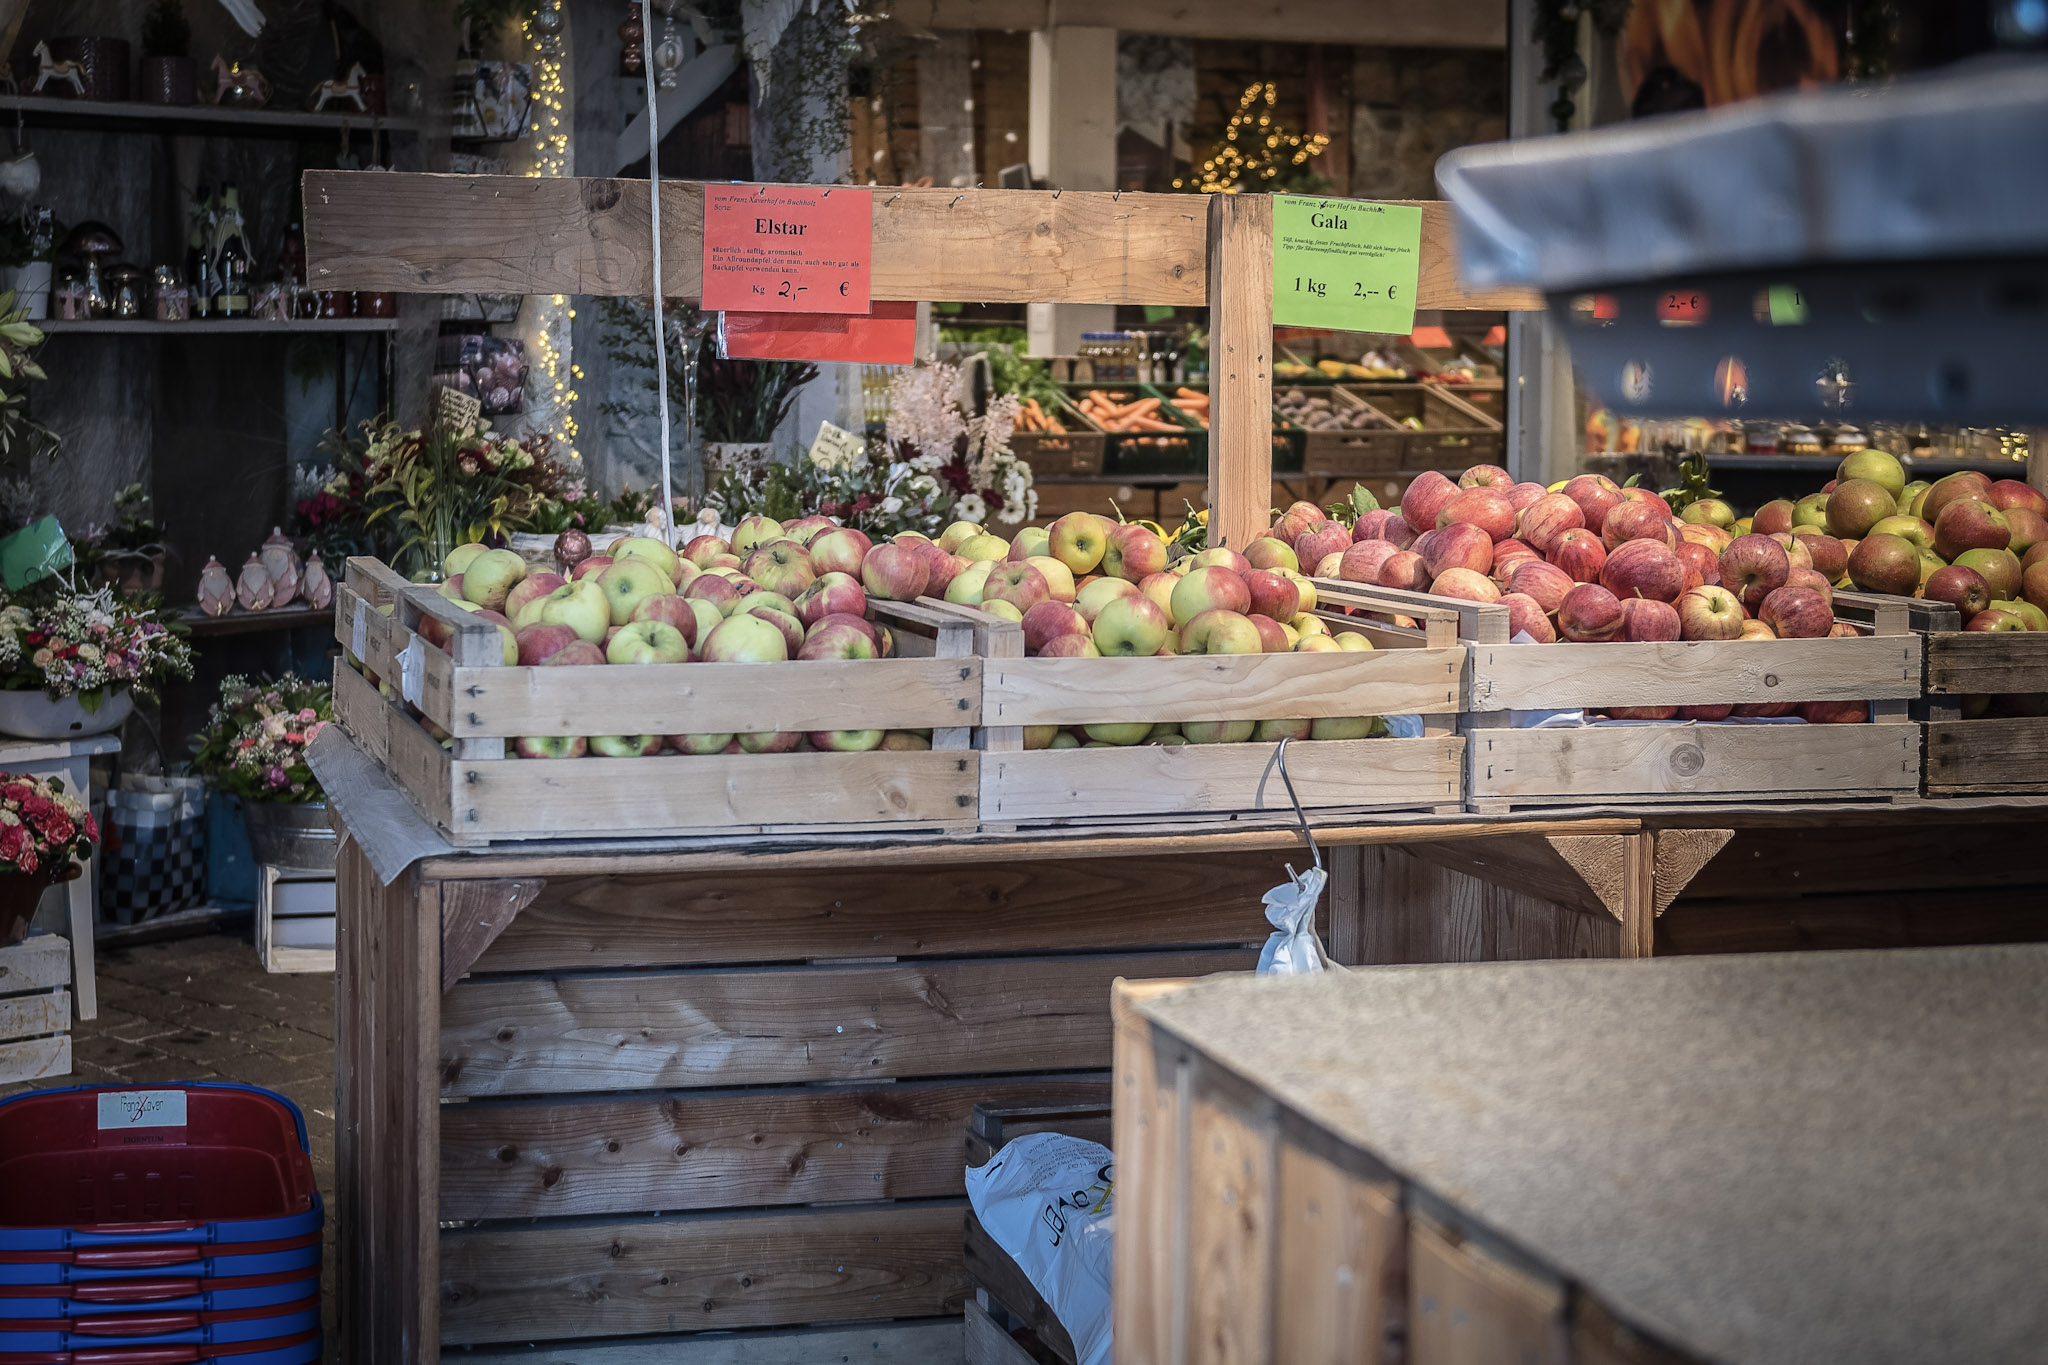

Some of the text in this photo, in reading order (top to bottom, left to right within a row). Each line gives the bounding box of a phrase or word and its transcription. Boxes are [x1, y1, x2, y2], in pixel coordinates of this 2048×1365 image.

[749, 197, 778, 205] Xaverhof
[755, 218, 807, 235] Elstar
[1311, 213, 1348, 230] Gala
[1304, 246, 1348, 255] Säureempfindliche
[727, 256, 771, 264] Allroundapfel
[712, 264, 743, 272] Backapfel
[752, 281, 850, 301] Kg 2,- €
[1294, 277, 1398, 300] 1 kg 2,-- €
[1690, 295, 1699, 309] €
[1795, 293, 1800, 305] 1
